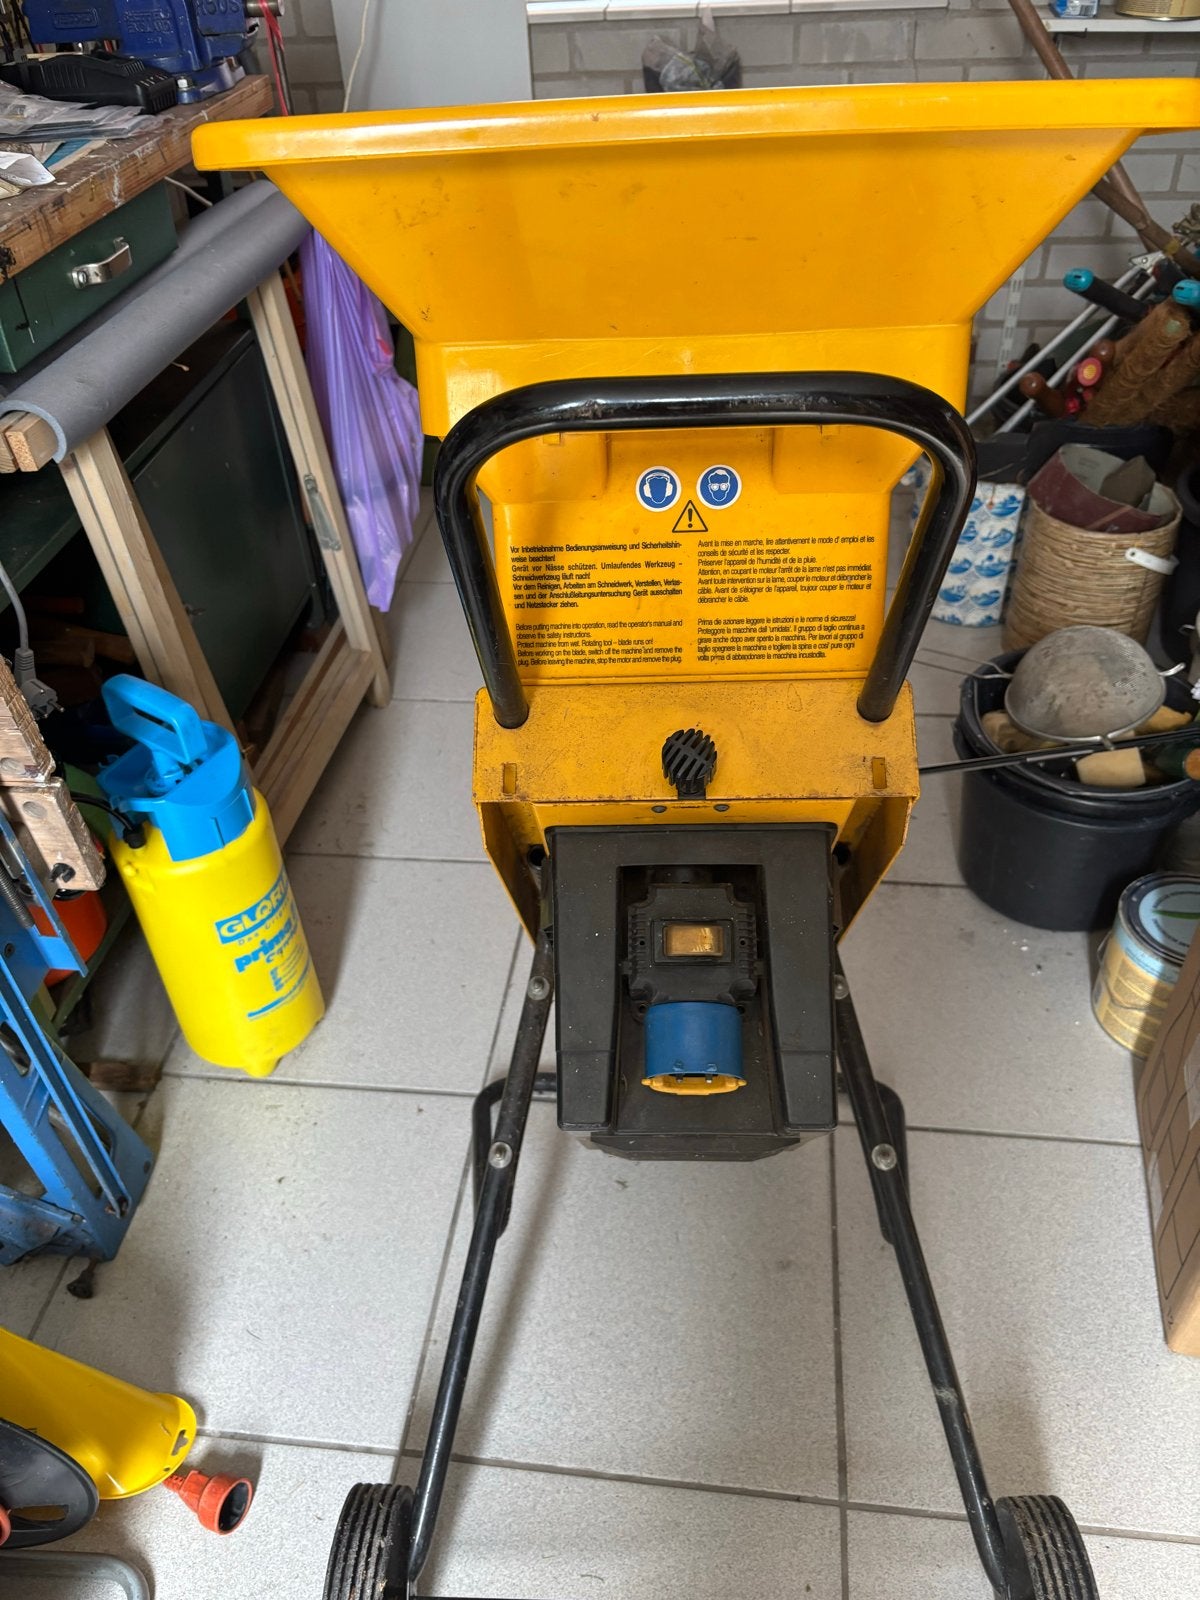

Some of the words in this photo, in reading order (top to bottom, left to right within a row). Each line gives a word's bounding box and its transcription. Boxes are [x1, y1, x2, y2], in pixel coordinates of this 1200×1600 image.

[698, 539, 713, 547] Avant
[720, 539, 734, 547] mise
[775, 536, 810, 545] attentivement
[841, 535, 859, 545] emploi
[521, 544, 564, 553] Inbetriebnahme
[566, 542, 627, 553] Bedienungsanweisung
[728, 548, 749, 556] sécurité
[511, 554, 527, 562] weise
[698, 558, 723, 566] Préserver
[724, 558, 747, 568] l'appareil
[757, 556, 781, 565] l'humidité
[803, 555, 817, 565] pluie.
[545, 563, 565, 571] Nässe
[568, 562, 598, 571] schützen.
[601, 561, 641, 569] Umlaufendes
[645, 560, 676, 570] Werkzeug
[731, 567, 752, 577] coupant
[759, 566, 777, 574] moteur
[822, 564, 835, 572] n'est
[512, 573, 560, 583] Schneidwerkzeug
[562, 572, 573, 580] läuft
[727, 576, 756, 584] intervention
[787, 576, 805, 584] couper
[812, 574, 830, 582] moteur
[837, 573, 866, 581] débrancher
[563, 581, 586, 589] Arbeiten
[714, 586, 729, 594] Avant
[819, 585, 838, 593] couper
[845, 582, 864, 590] moteur
[633, 589, 648, 597] Gerät
[650, 588, 683, 596] ausschalten
[560, 599, 579, 607] ziehen.
[698, 595, 727, 603] débrancher
[533, 622, 550, 632] putting
[550, 622, 571, 630] machine
[572, 621, 581, 629] into
[582, 621, 606, 631] operation,
[607, 620, 619, 628] read
[653, 619, 672, 627] manual
[698, 617, 713, 625] Prima
[723, 617, 744, 625] azionare
[772, 616, 794, 624] istruzioni
[733, 625, 757, 633] macchina
[798, 626, 816, 634] gruppo
[823, 624, 837, 633] taglio
[838, 623, 860, 631] continua
[547, 631, 561, 640] safety
[563, 630, 592, 638] instructions.
[698, 635, 712, 645] girare
[713, 635, 729, 643] anche
[730, 635, 743, 644] dopo
[757, 634, 774, 644] spento
[781, 633, 807, 641] macchina.
[839, 634, 858, 642] gruppo
[535, 639, 556, 647] machine
[558, 639, 569, 647] from
[582, 638, 602, 648] Rotating
[603, 638, 612, 646] tool
[618, 637, 632, 645] blade
[698, 644, 711, 654] taglio
[712, 645, 736, 654] spegnere
[742, 643, 767, 651] macchina
[773, 643, 791, 653] togliere
[798, 642, 812, 652] spina
[830, 642, 842, 651] pure
[843, 640, 855, 650] ogni
[535, 648, 554, 658] working
[621, 646, 642, 654] machine
[697, 653, 710, 661] volta
[711, 653, 725, 663] prima
[731, 652, 765, 660] abbandonare
[773, 651, 797, 659] macchina
[530, 657, 547, 665] Before
[597, 656, 608, 665] stop
[616, 655, 631, 663] motor
